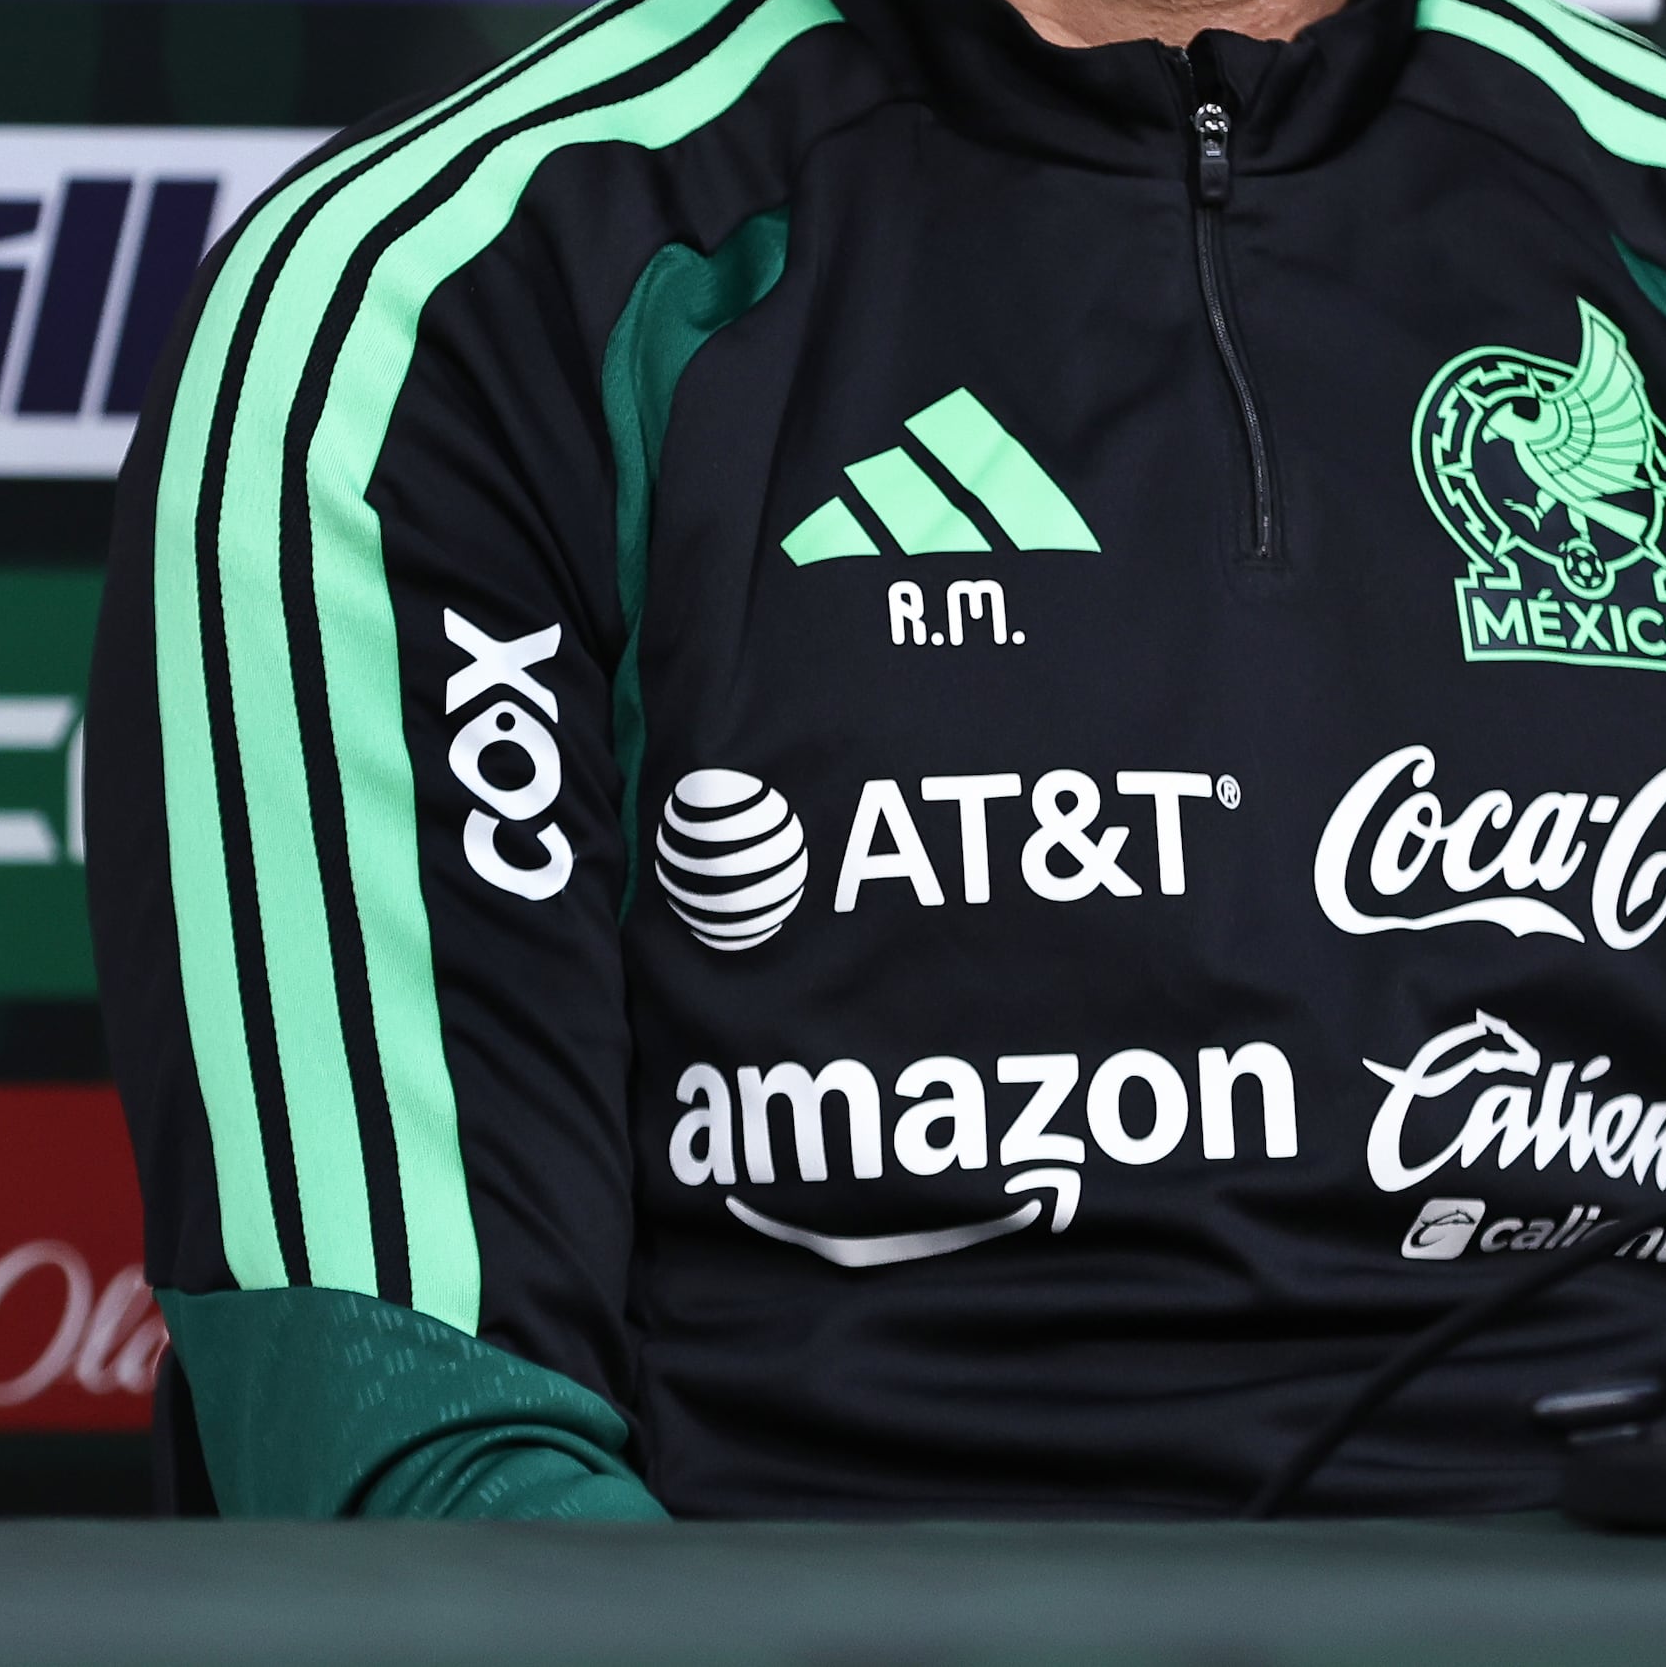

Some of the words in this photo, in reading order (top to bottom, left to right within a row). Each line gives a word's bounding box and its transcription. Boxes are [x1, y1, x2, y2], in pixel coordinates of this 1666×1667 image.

[887, 578, 1027, 647] R.M.
[833, 768, 1213, 914] AT&T
[668, 1040, 1299, 1187] amazon
